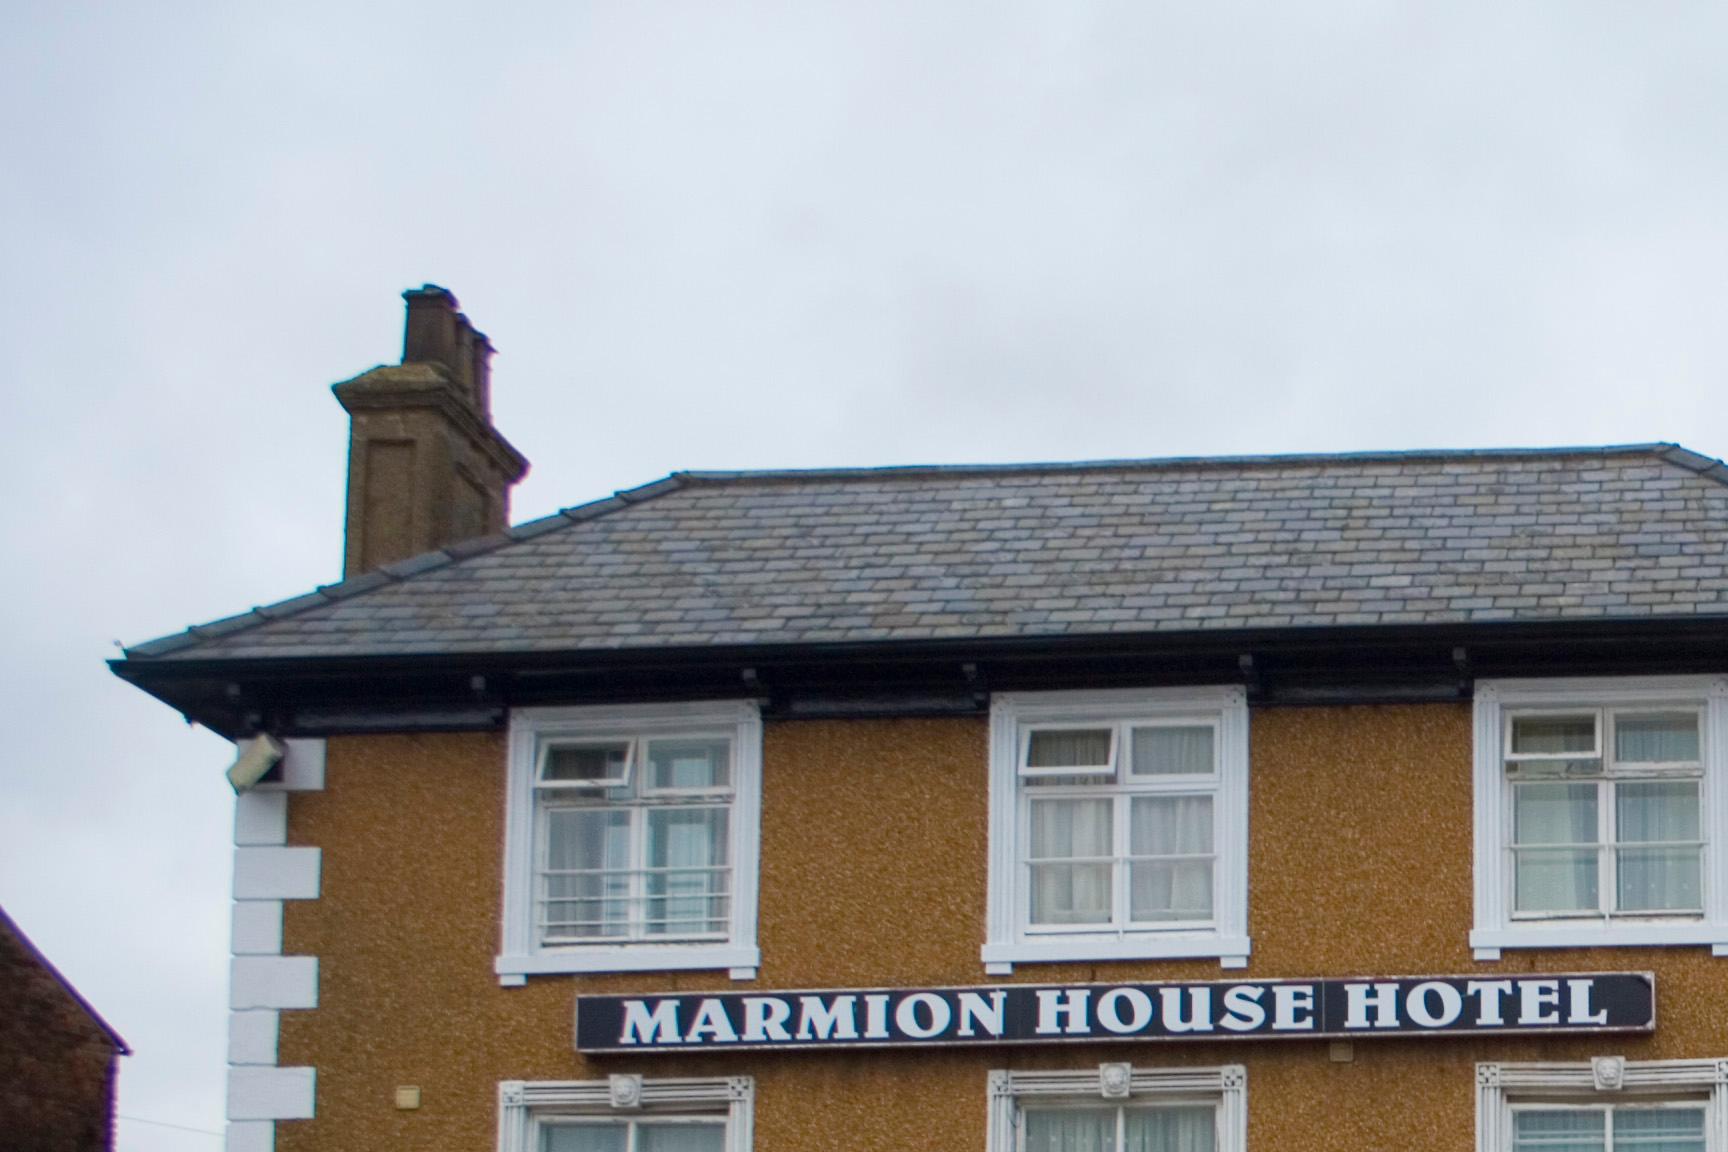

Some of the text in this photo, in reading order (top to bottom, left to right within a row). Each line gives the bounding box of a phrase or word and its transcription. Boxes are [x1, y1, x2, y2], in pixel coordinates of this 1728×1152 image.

[619, 978, 1608, 1045] MARMION HOUSE HOTEL
